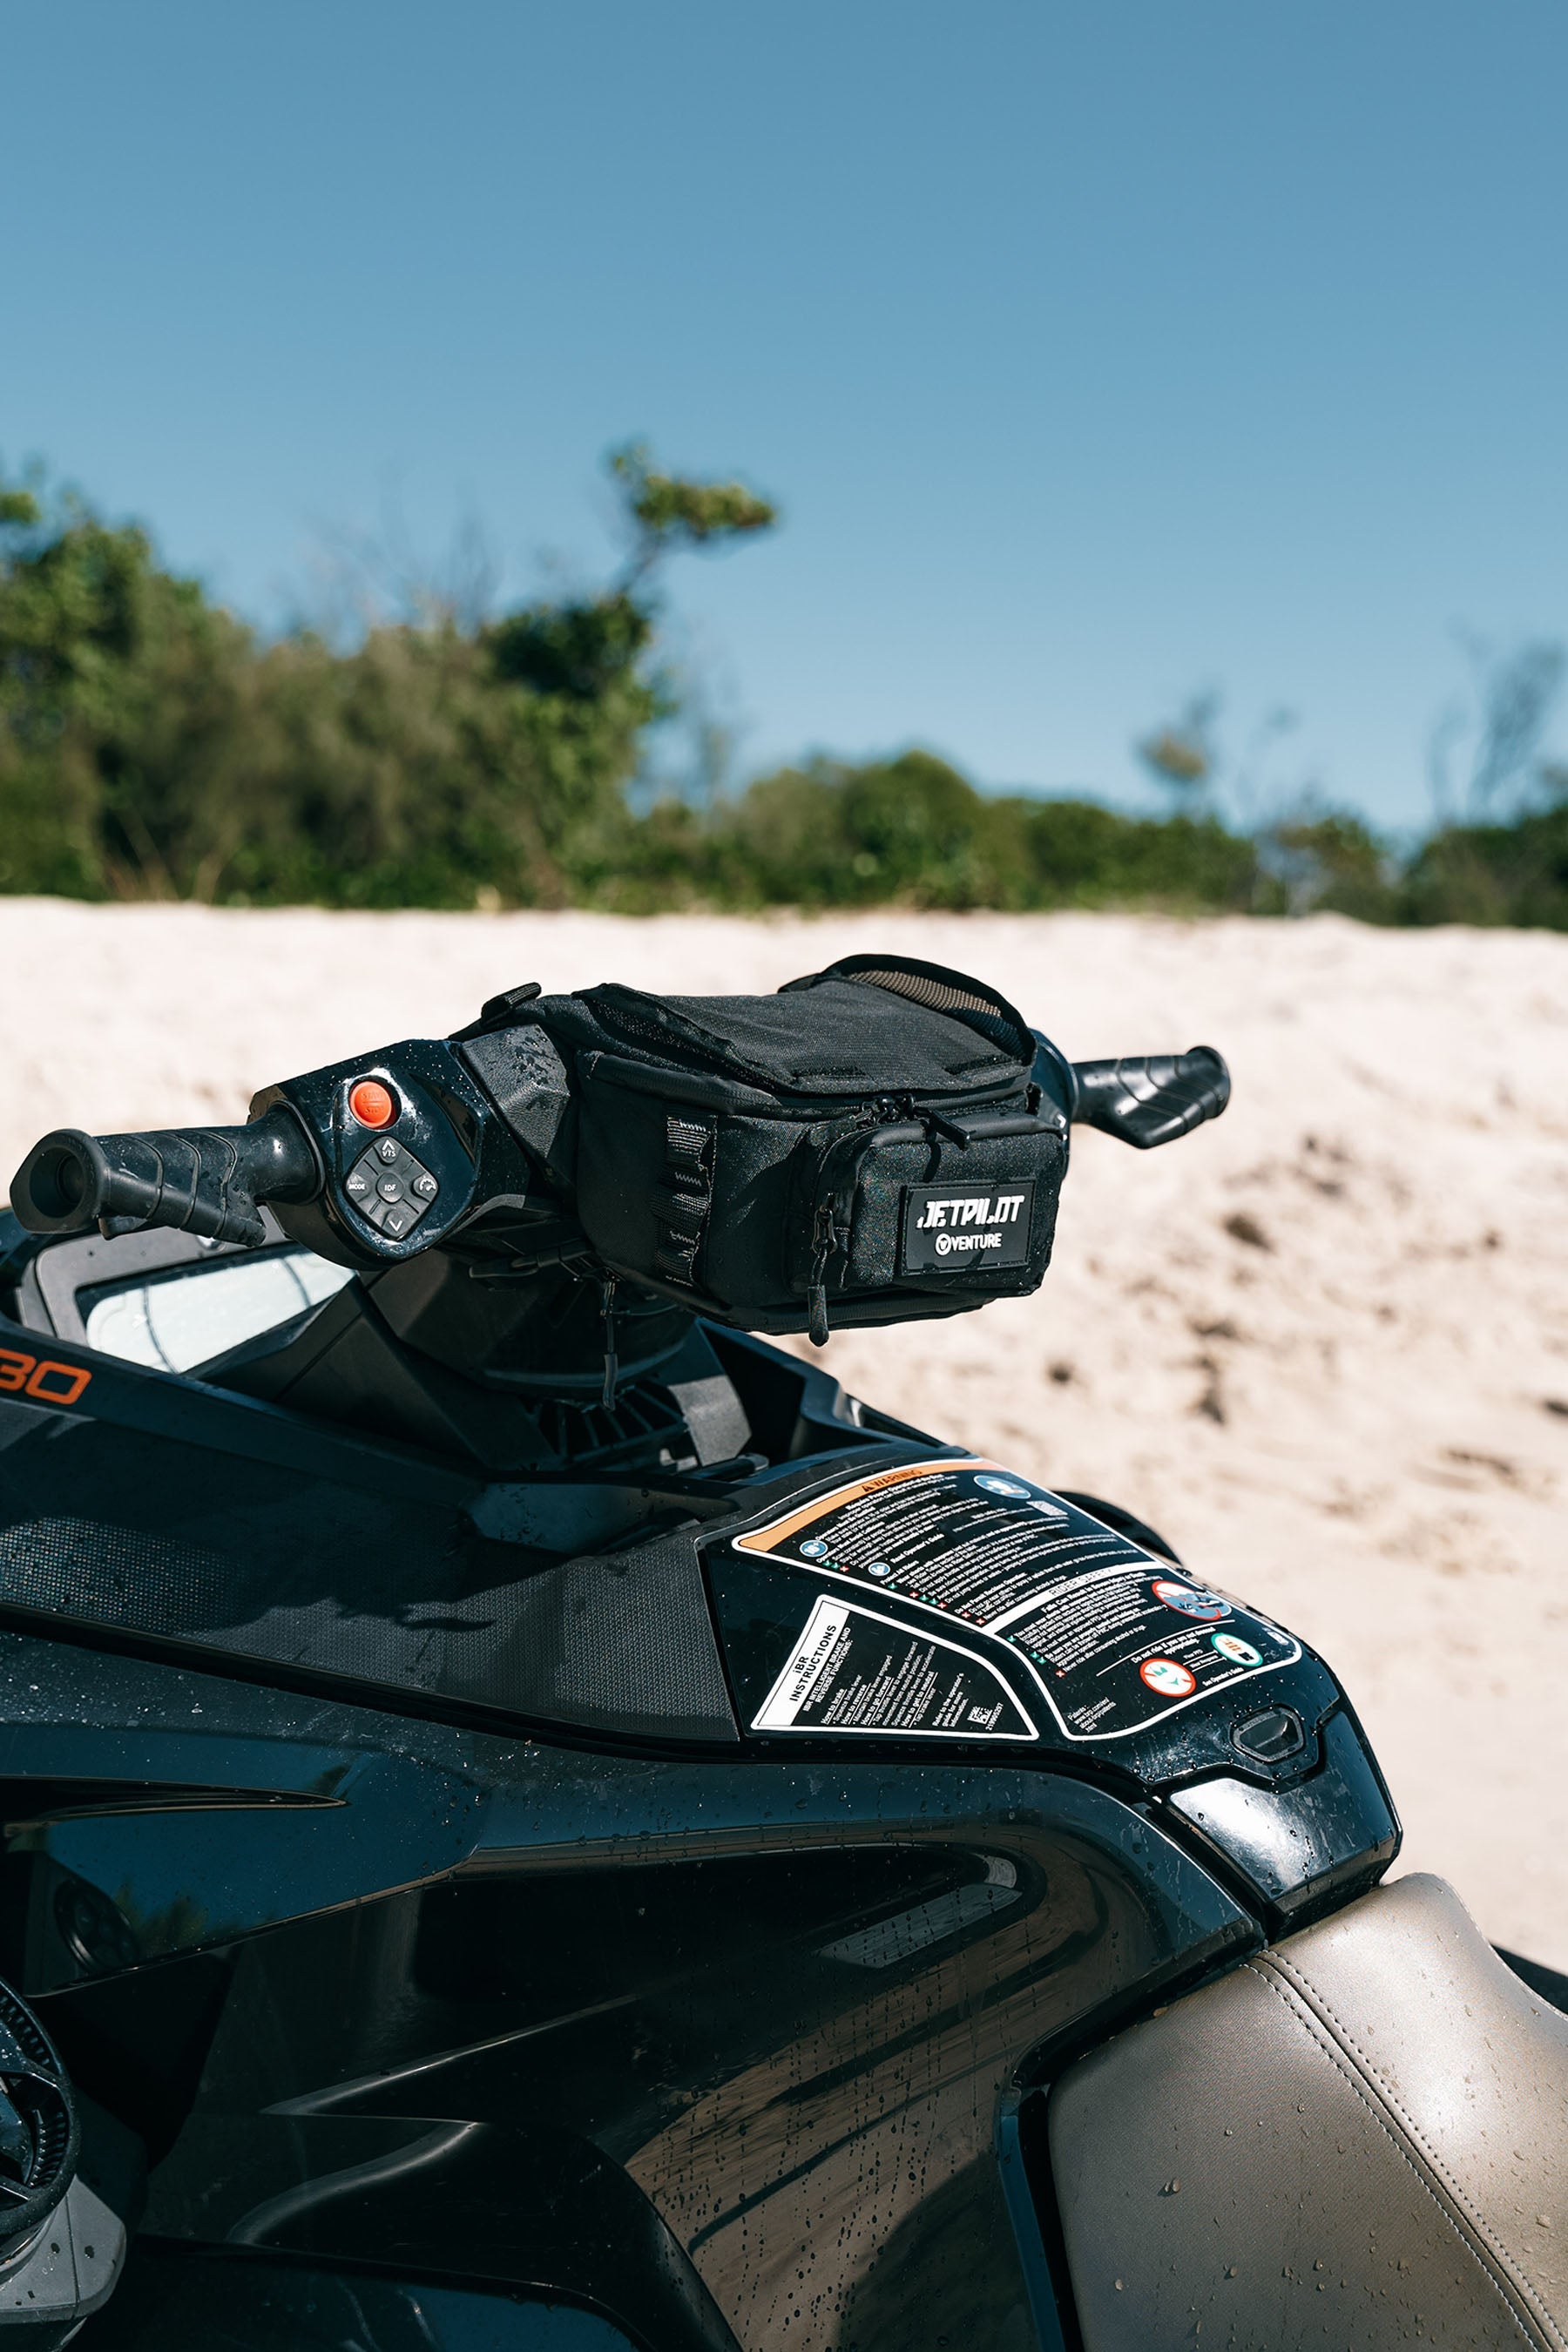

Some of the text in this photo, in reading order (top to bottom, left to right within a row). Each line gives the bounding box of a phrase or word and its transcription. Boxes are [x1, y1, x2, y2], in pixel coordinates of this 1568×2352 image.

[916, 1195, 1024, 1229] JETPILOT
[951, 1233, 1003, 1251] VENTURE
[1049, 1569, 1112, 1596] RIDER SAFETY
[789, 1625, 836, 1701] INSTRUCTIONS
[794, 1657, 808, 1673] iBR
[808, 1663, 833, 1700] INTELLIGENT
[829, 1642, 844, 1662] BRAKE
[841, 1627, 850, 1641] AND
[815, 1675, 835, 1702] REVERSE
